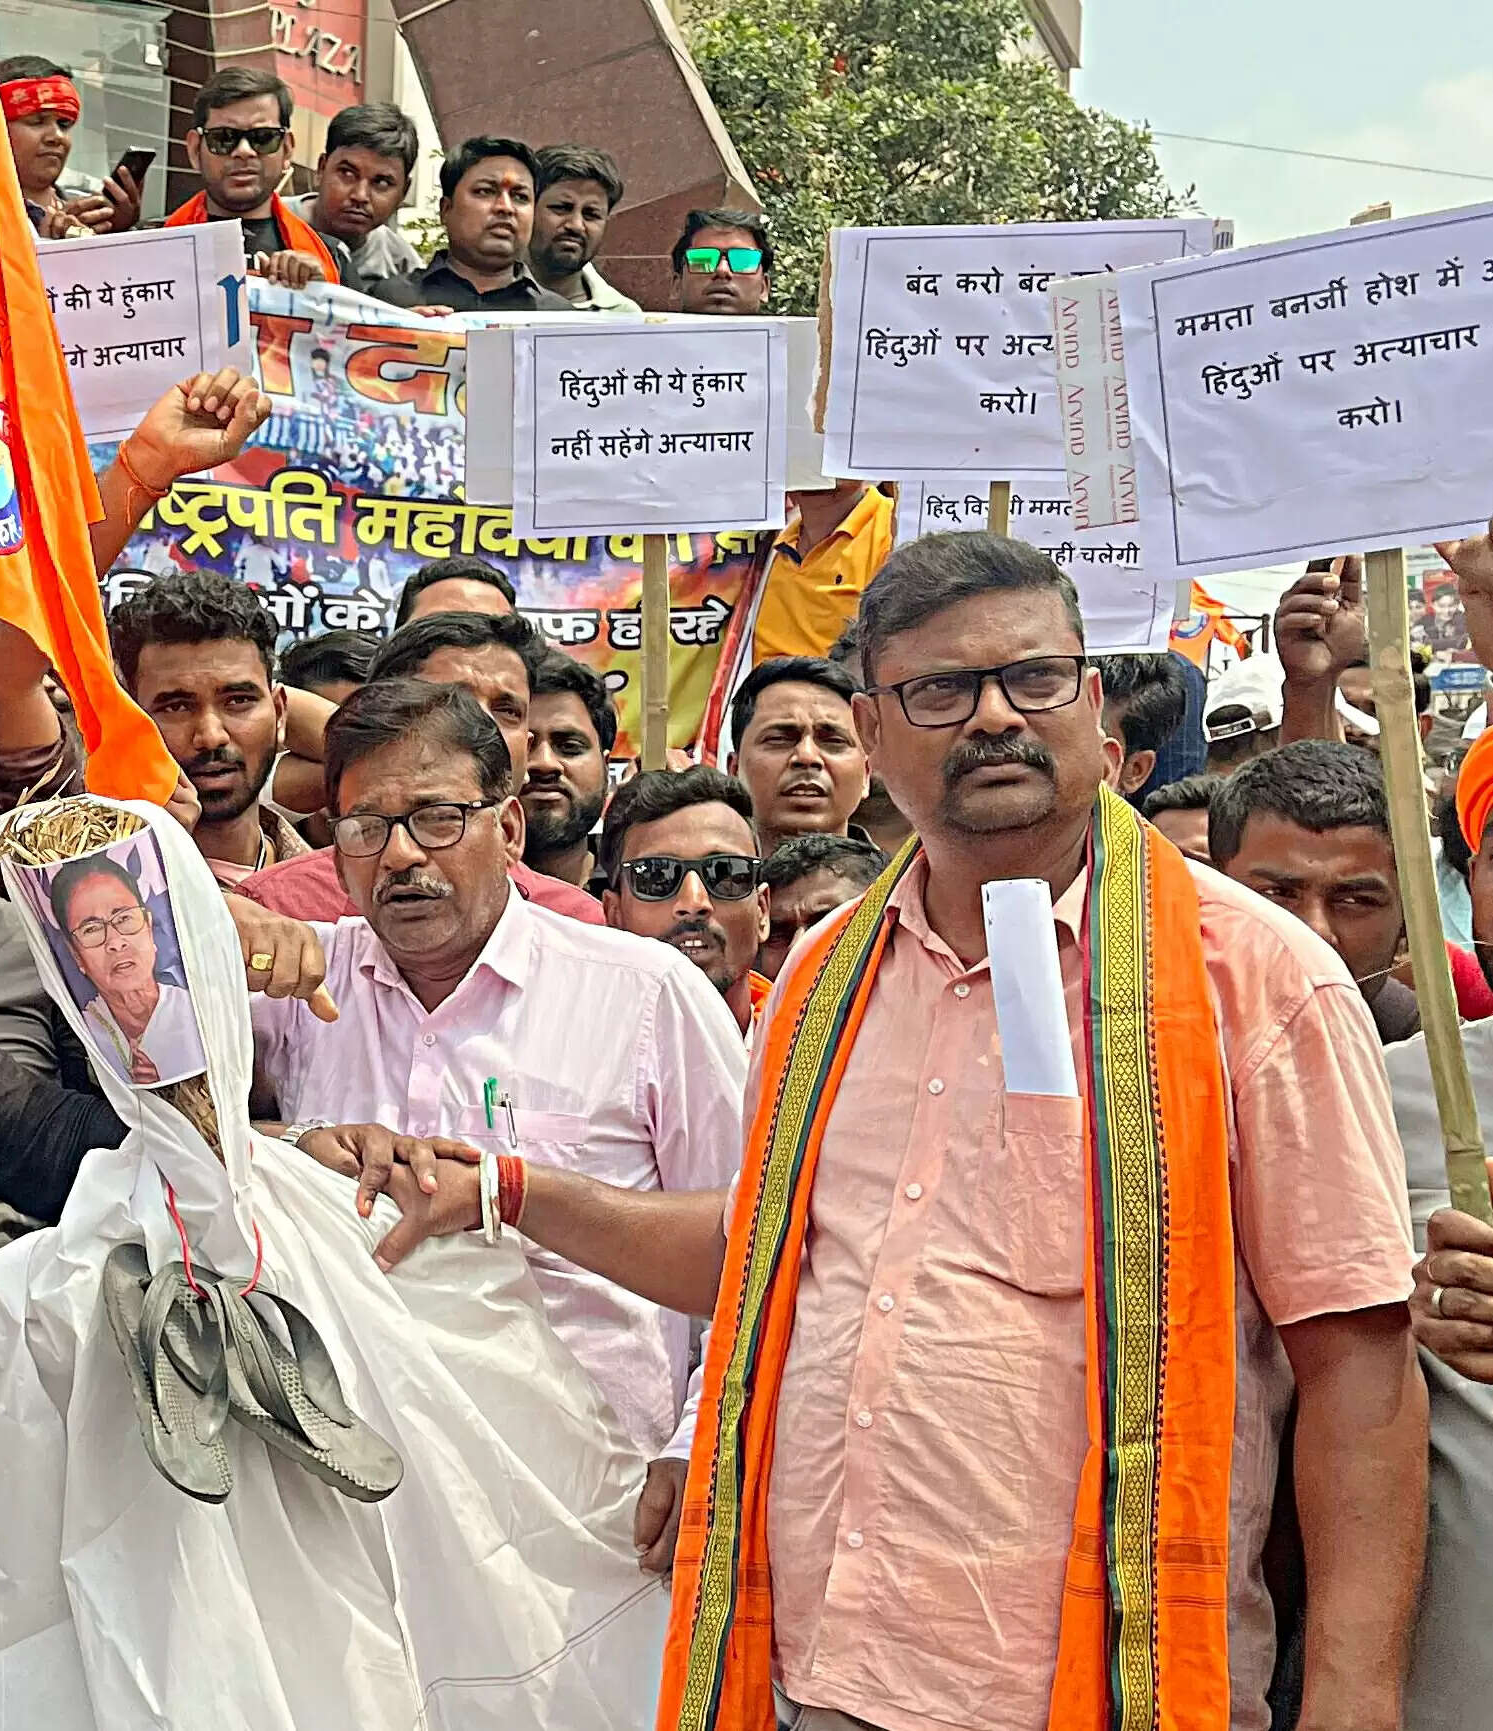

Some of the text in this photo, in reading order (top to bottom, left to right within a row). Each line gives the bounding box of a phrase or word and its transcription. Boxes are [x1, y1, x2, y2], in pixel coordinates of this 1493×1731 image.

[269, 7, 362, 85] PLAZA
[62, 283, 93, 311] की
[95, 280, 117, 307] ये
[119, 276, 176, 320] हुंकार
[905, 265, 944, 297] बंद
[955, 265, 1005, 295] करो
[1174, 303, 1255, 337] ममता
[1268, 275, 1349, 319] बनर्जी
[1363, 271, 1421, 306] होश
[1435, 255, 1465, 288] में
[92, 336, 187, 367] अत्याचार
[865, 326, 1055, 368] हिंदुओं पर अत्य
[1200, 323, 1481, 401] हिंदुओं पर अत्याचार
[558, 365, 748, 409] हिंदुओं की ये हुंकार
[979, 385, 1037, 415] करो।
[1336, 395, 1402, 430] करो।
[550, 426, 755, 461] नहीं सहेंगे अत्याचार
[925, 494, 962, 524] हिंदू
[1028, 500, 1073, 516] ममत
[1079, 541, 1141, 568] चलेगी
